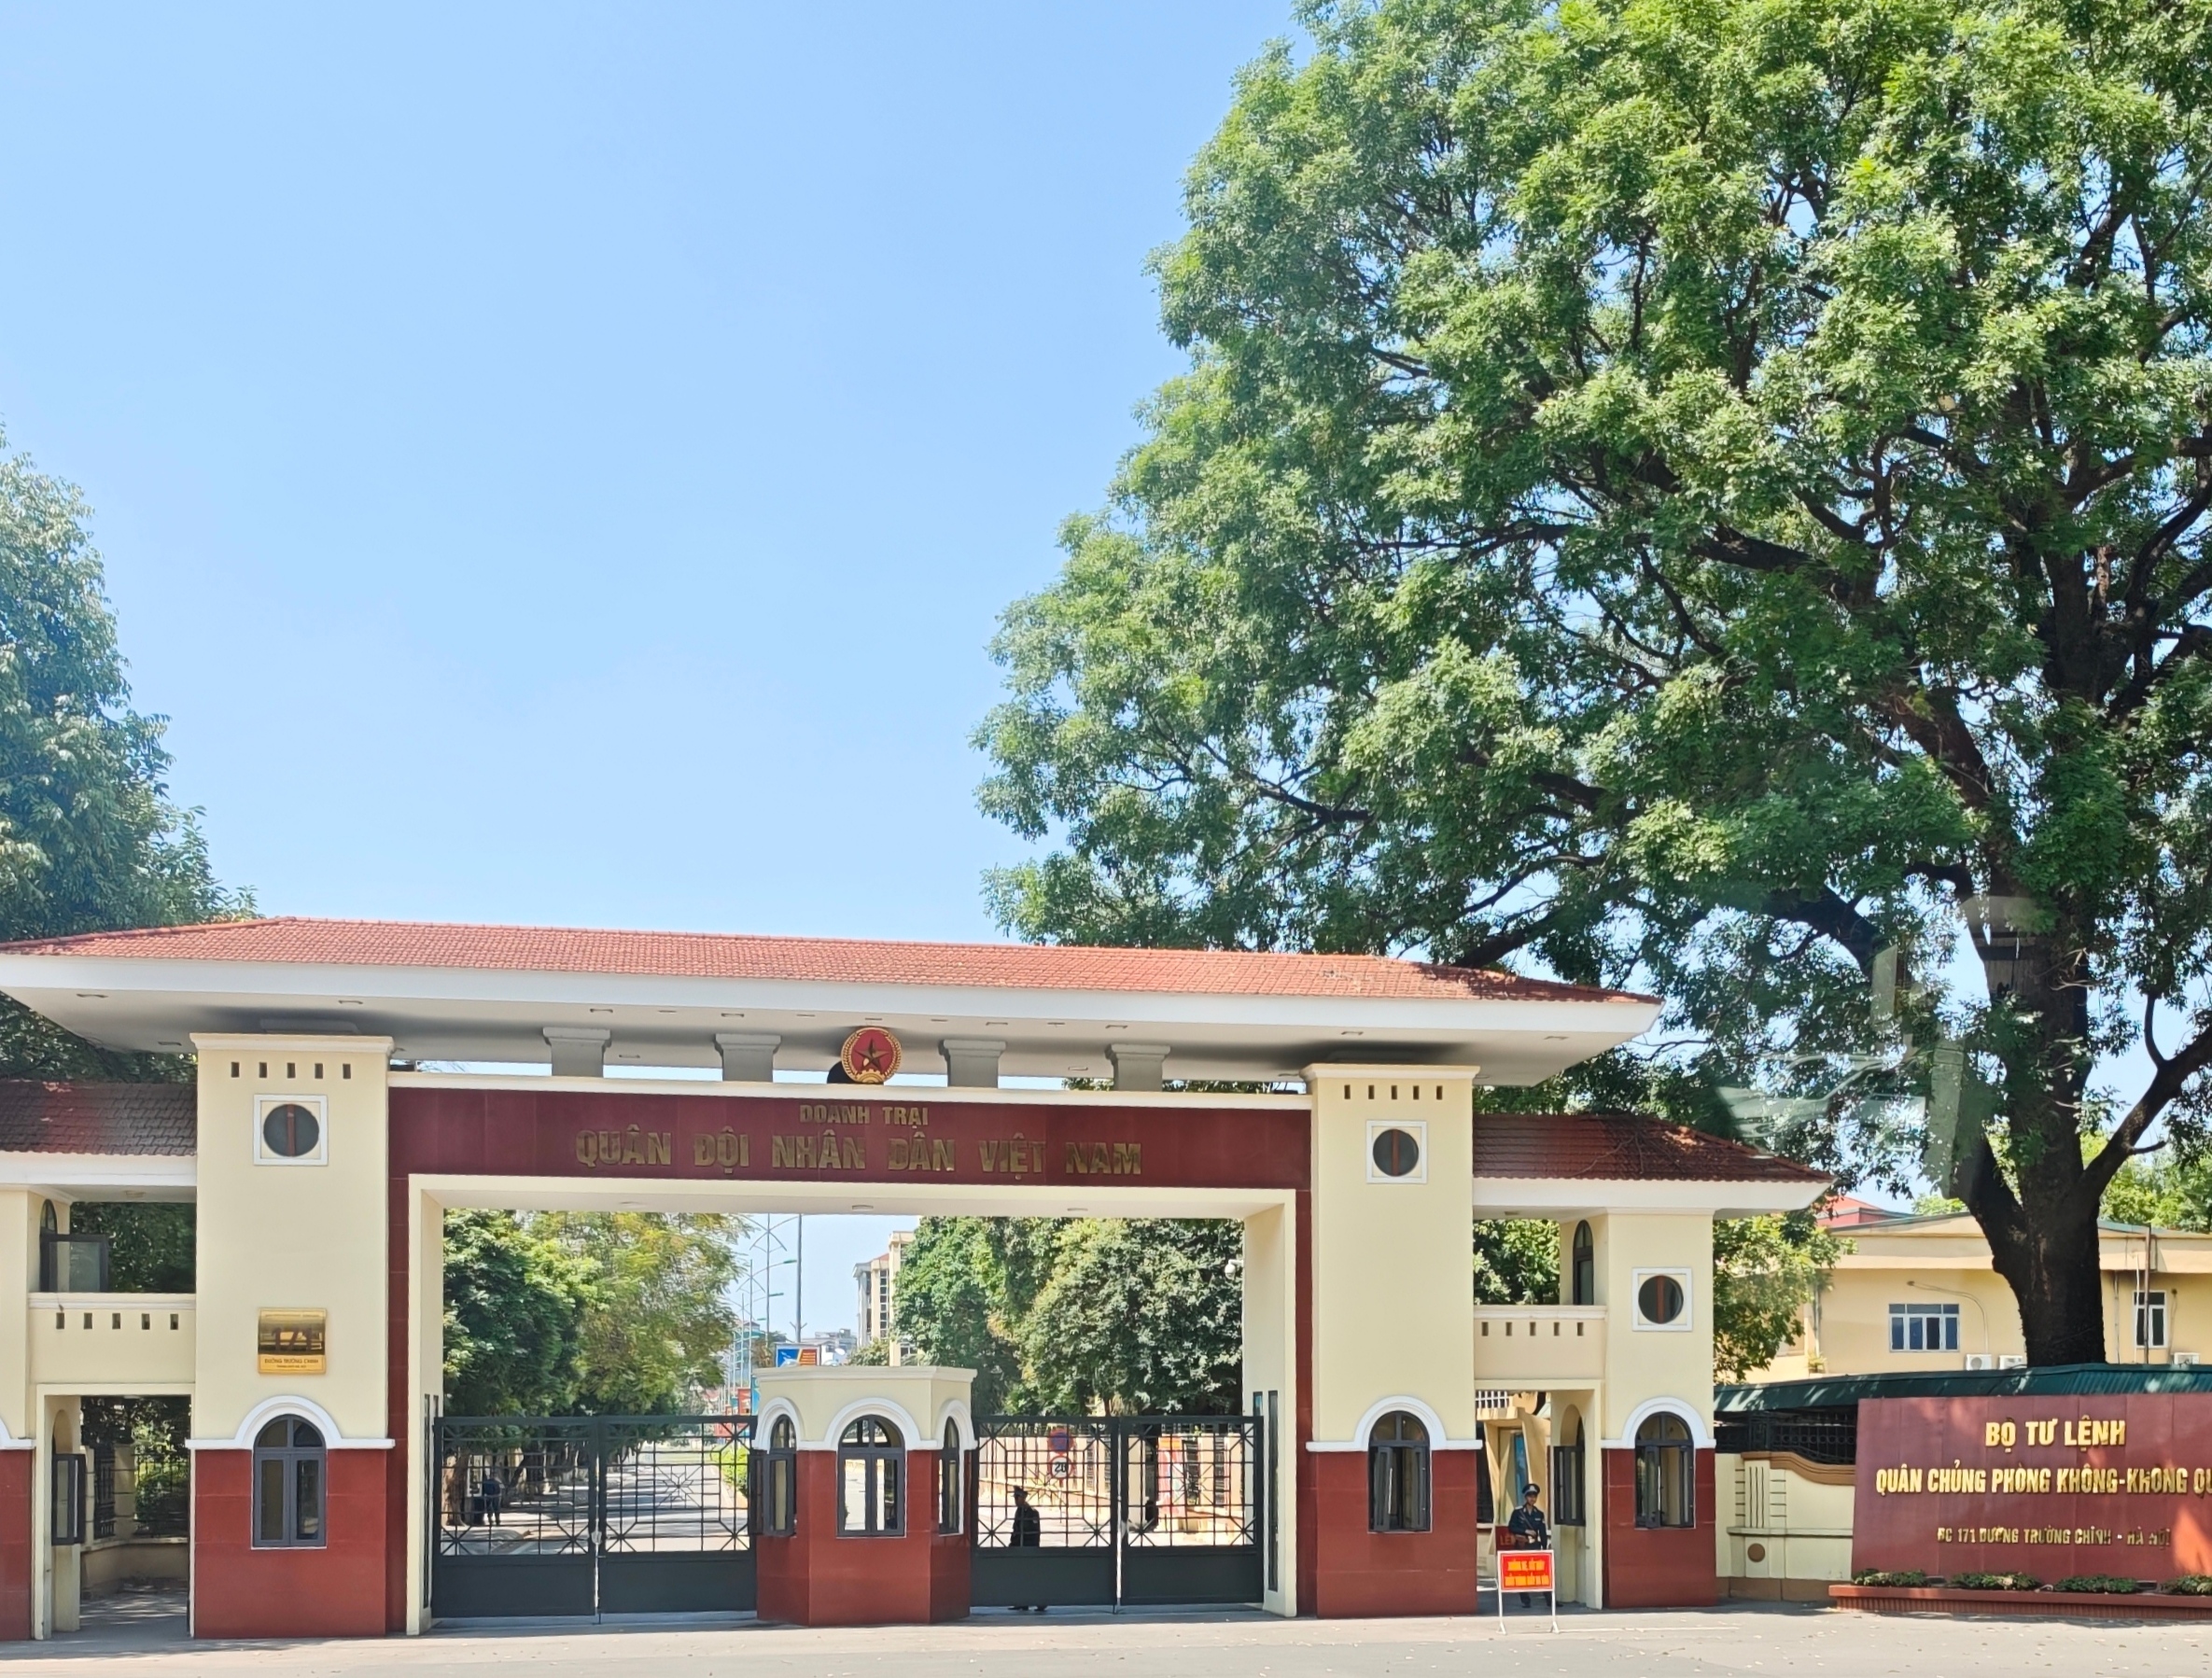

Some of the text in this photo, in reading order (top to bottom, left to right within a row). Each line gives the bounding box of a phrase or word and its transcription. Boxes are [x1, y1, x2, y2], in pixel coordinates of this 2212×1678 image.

[800, 1104, 929, 1129] DOANH TRẠI
[575, 1124, 1141, 1181] QUÂN ĐỘI NHÂN DÂN VIỆT NAM
[1985, 1415, 2126, 1453] BỘ TƯ LỆNH
[1876, 1463, 1923, 1496] QUÂN
[1927, 1459, 1986, 1493] CHỦNG
[1991, 1462, 2051, 1493] PHÒNG
[1957, 1528, 1976, 1544] 171
[2126, 1525, 2144, 1545] HÀ
